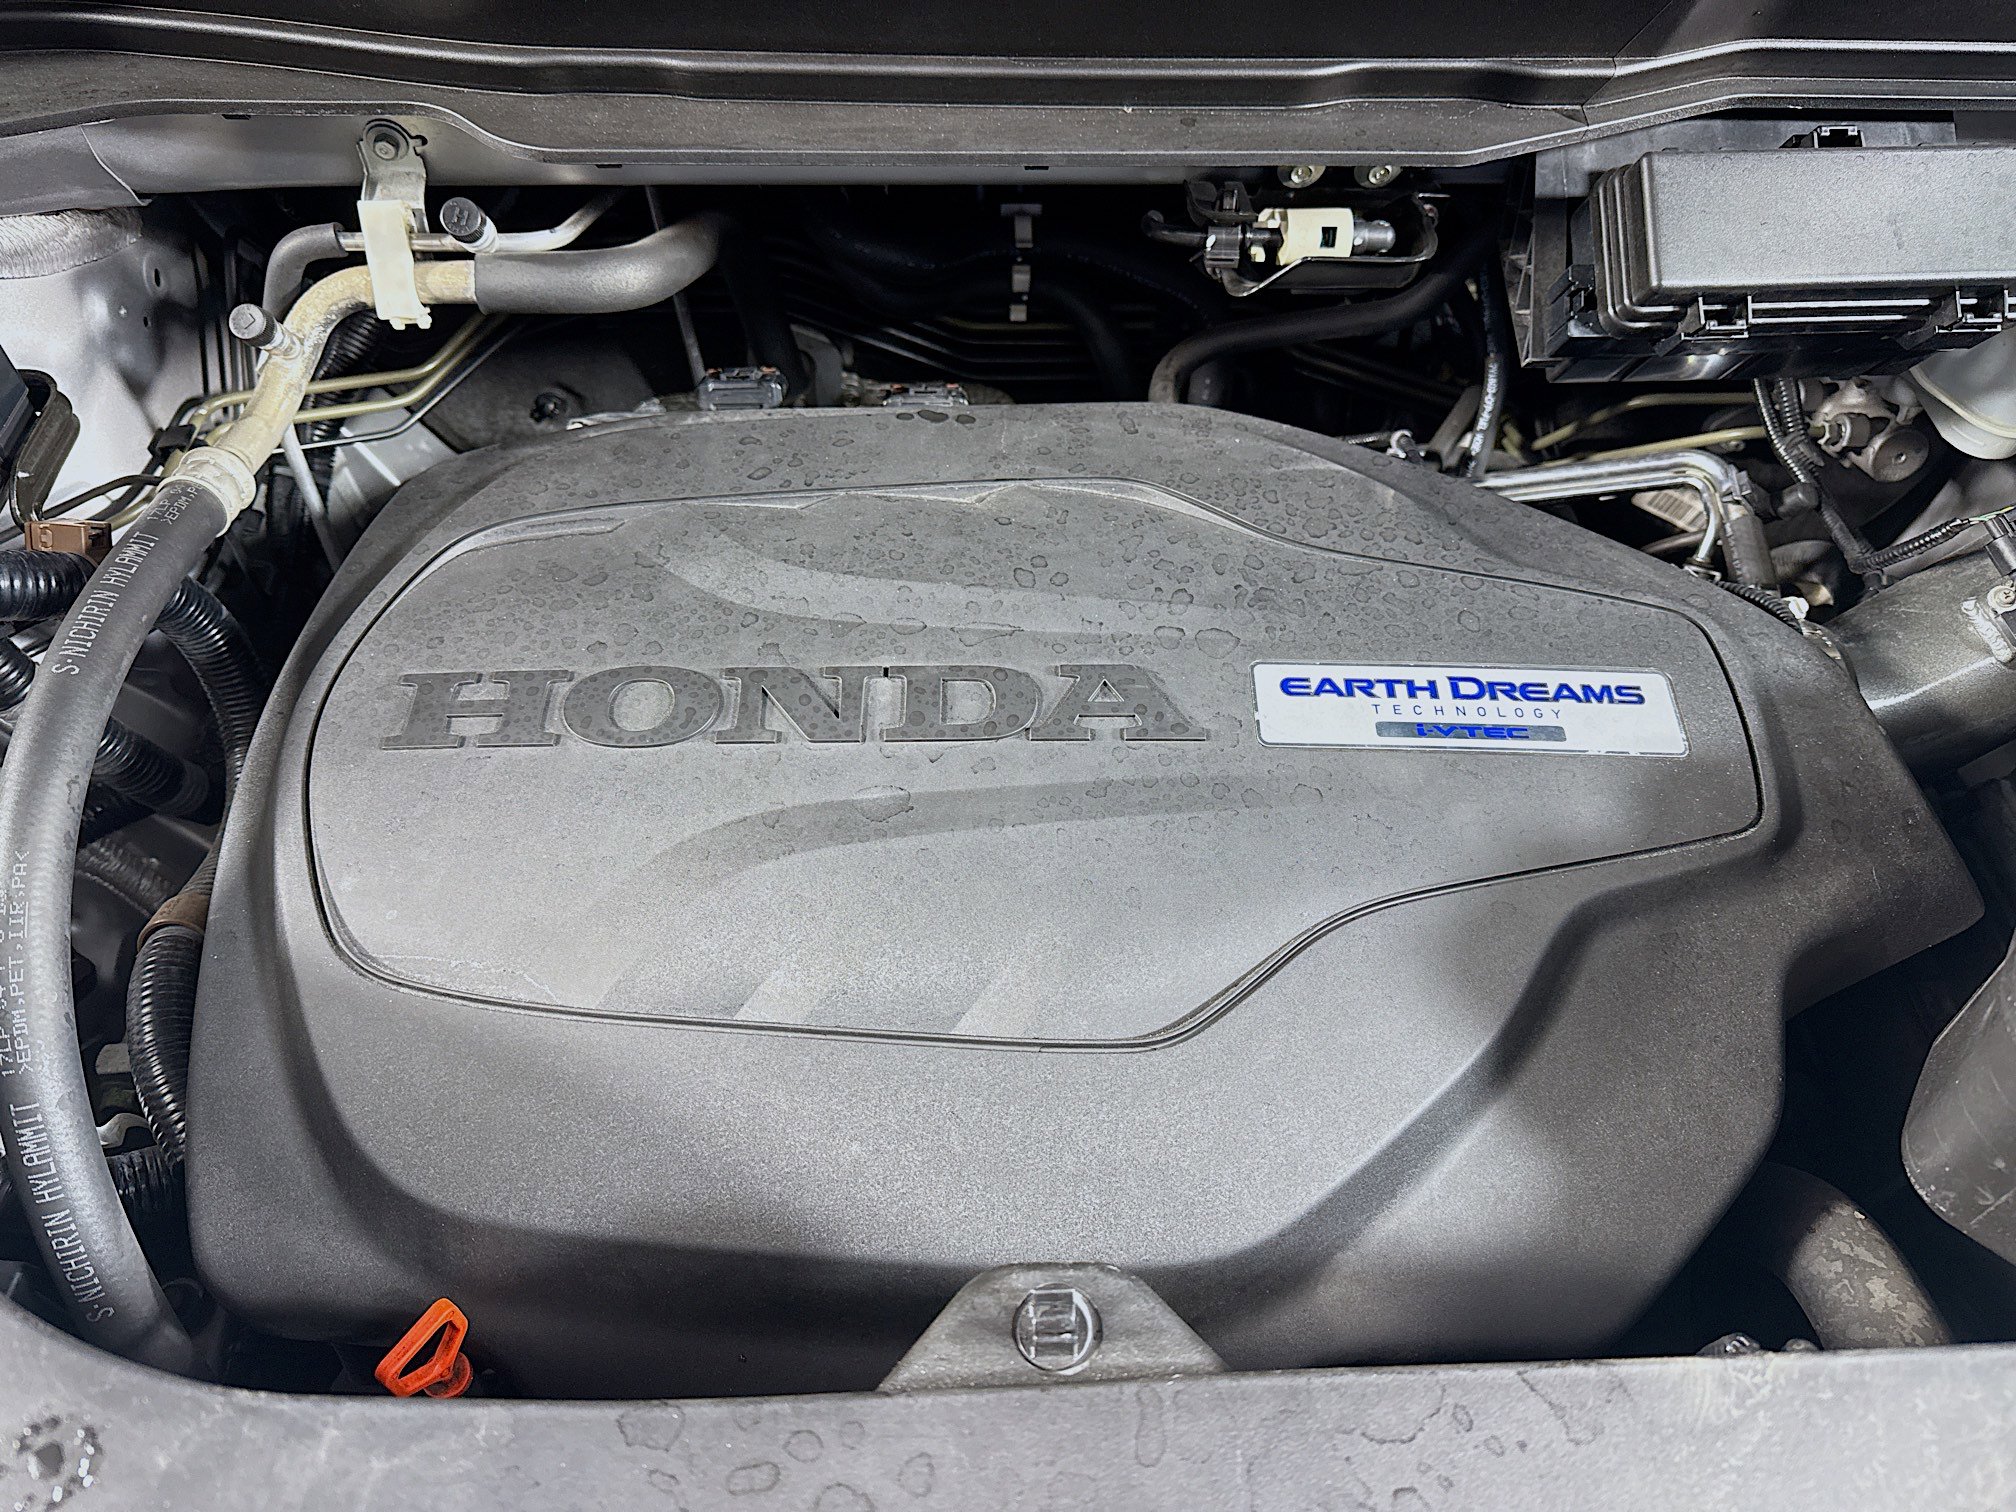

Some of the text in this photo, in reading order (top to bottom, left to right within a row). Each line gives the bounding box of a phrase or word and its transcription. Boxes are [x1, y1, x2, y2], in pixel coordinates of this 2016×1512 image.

[100, 531, 159, 588] HYLAMMIT
[380, 664, 1208, 750] HONDA
[1280, 675, 1646, 706] EARTH DREAMS
[1373, 704, 1562, 720] TECHNOLOGY
[1416, 722, 1530, 740] i-VTEC
[9, 1102, 65, 1204] HYLAMMIT
